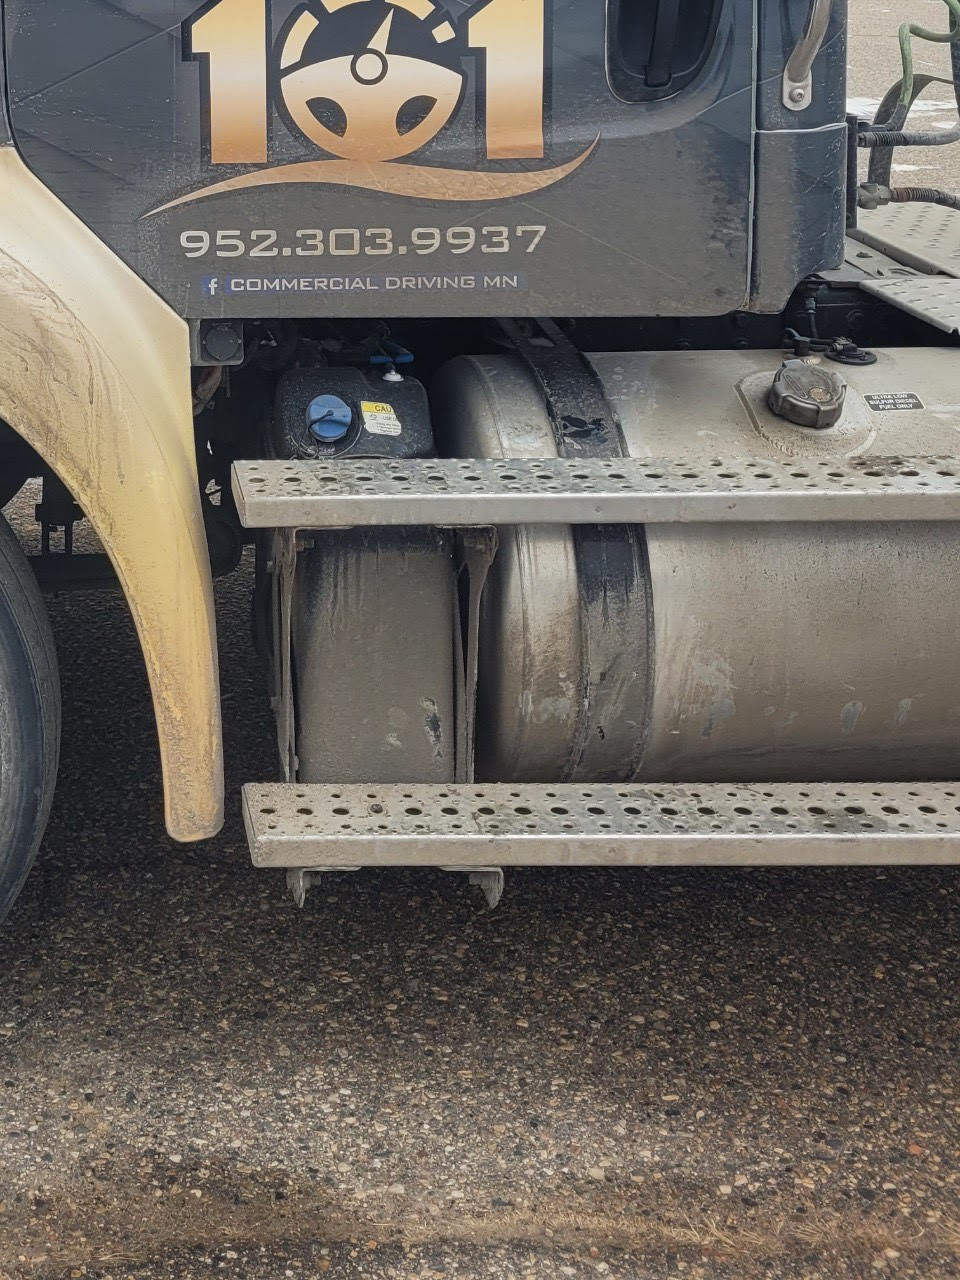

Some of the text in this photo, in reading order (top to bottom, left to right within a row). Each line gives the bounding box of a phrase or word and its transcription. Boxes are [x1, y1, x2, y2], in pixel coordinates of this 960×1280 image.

[179, 224, 546, 259] 952.303.9937
[230, 277, 379, 291] COMMERCIAL
[385, 275, 476, 290] DRIVING
[483, 275, 518, 289] MN
